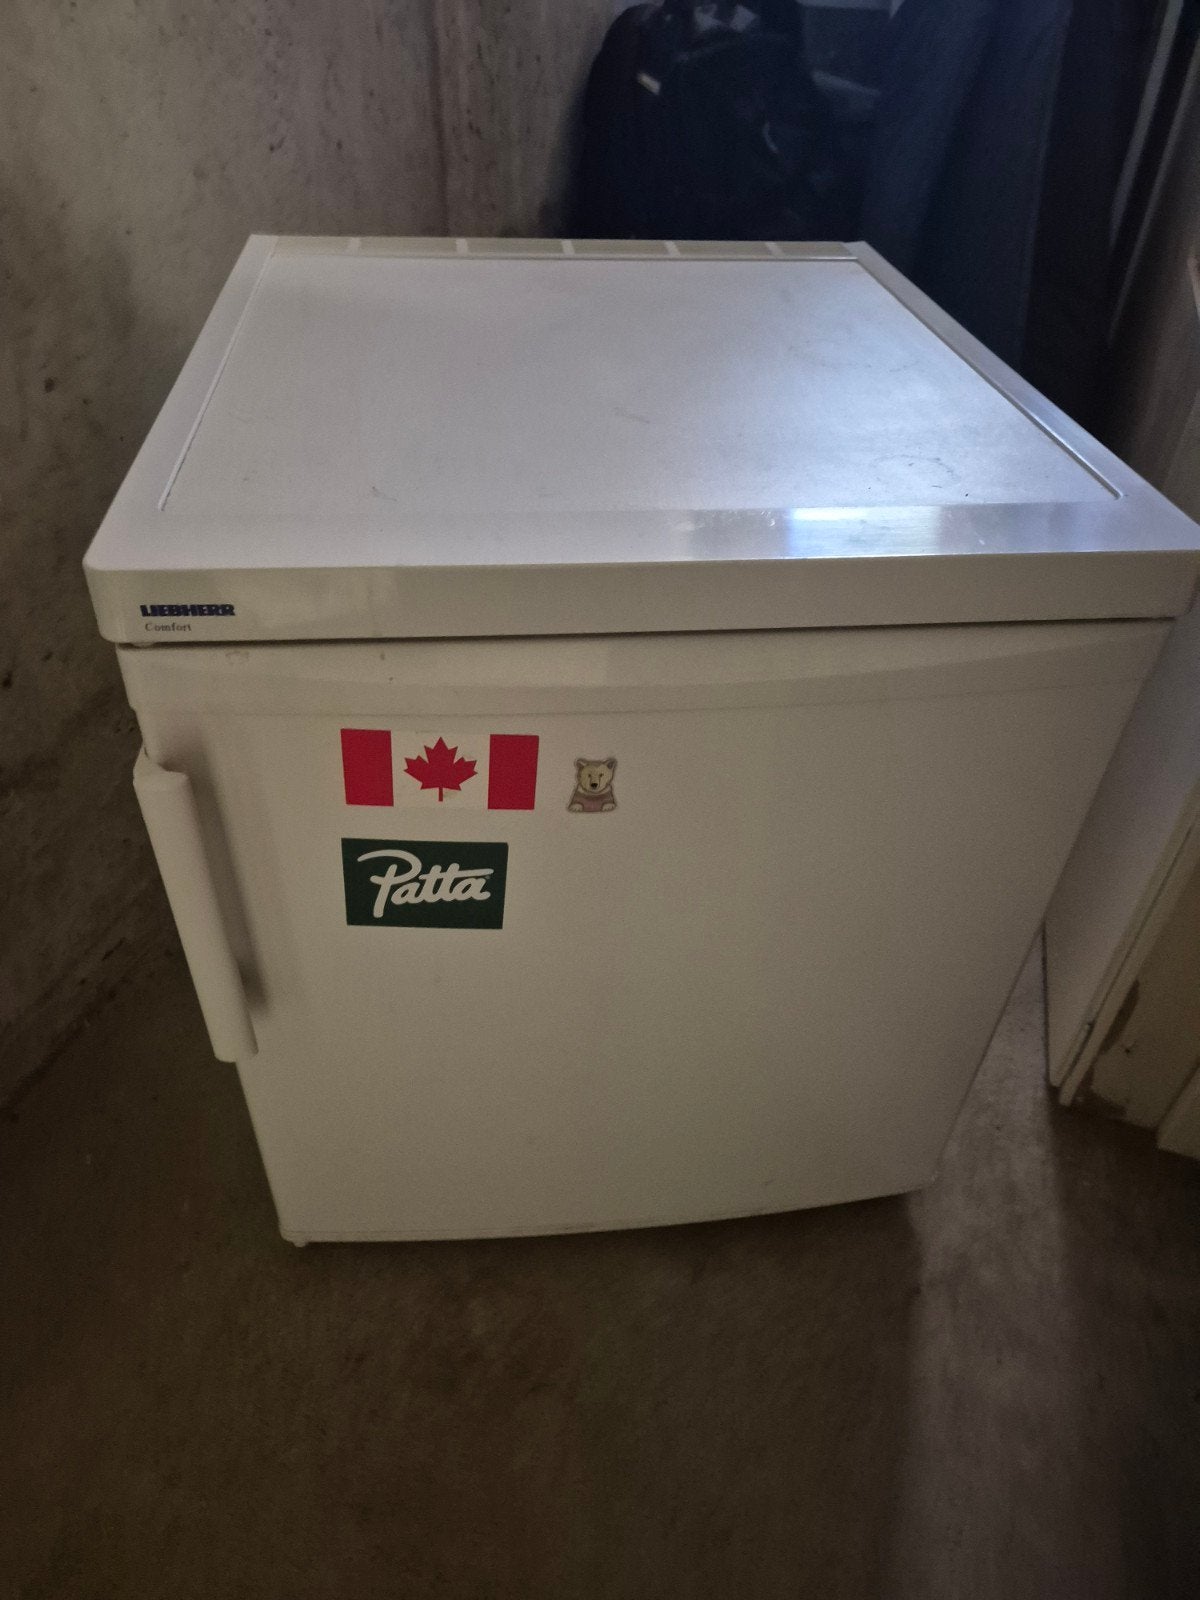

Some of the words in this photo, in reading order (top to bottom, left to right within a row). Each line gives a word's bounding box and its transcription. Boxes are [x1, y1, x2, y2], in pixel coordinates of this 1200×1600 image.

[140, 604, 236, 617] LIEBHERR
[144, 622, 192, 632] Comfort
[357, 849, 495, 918] Patta
